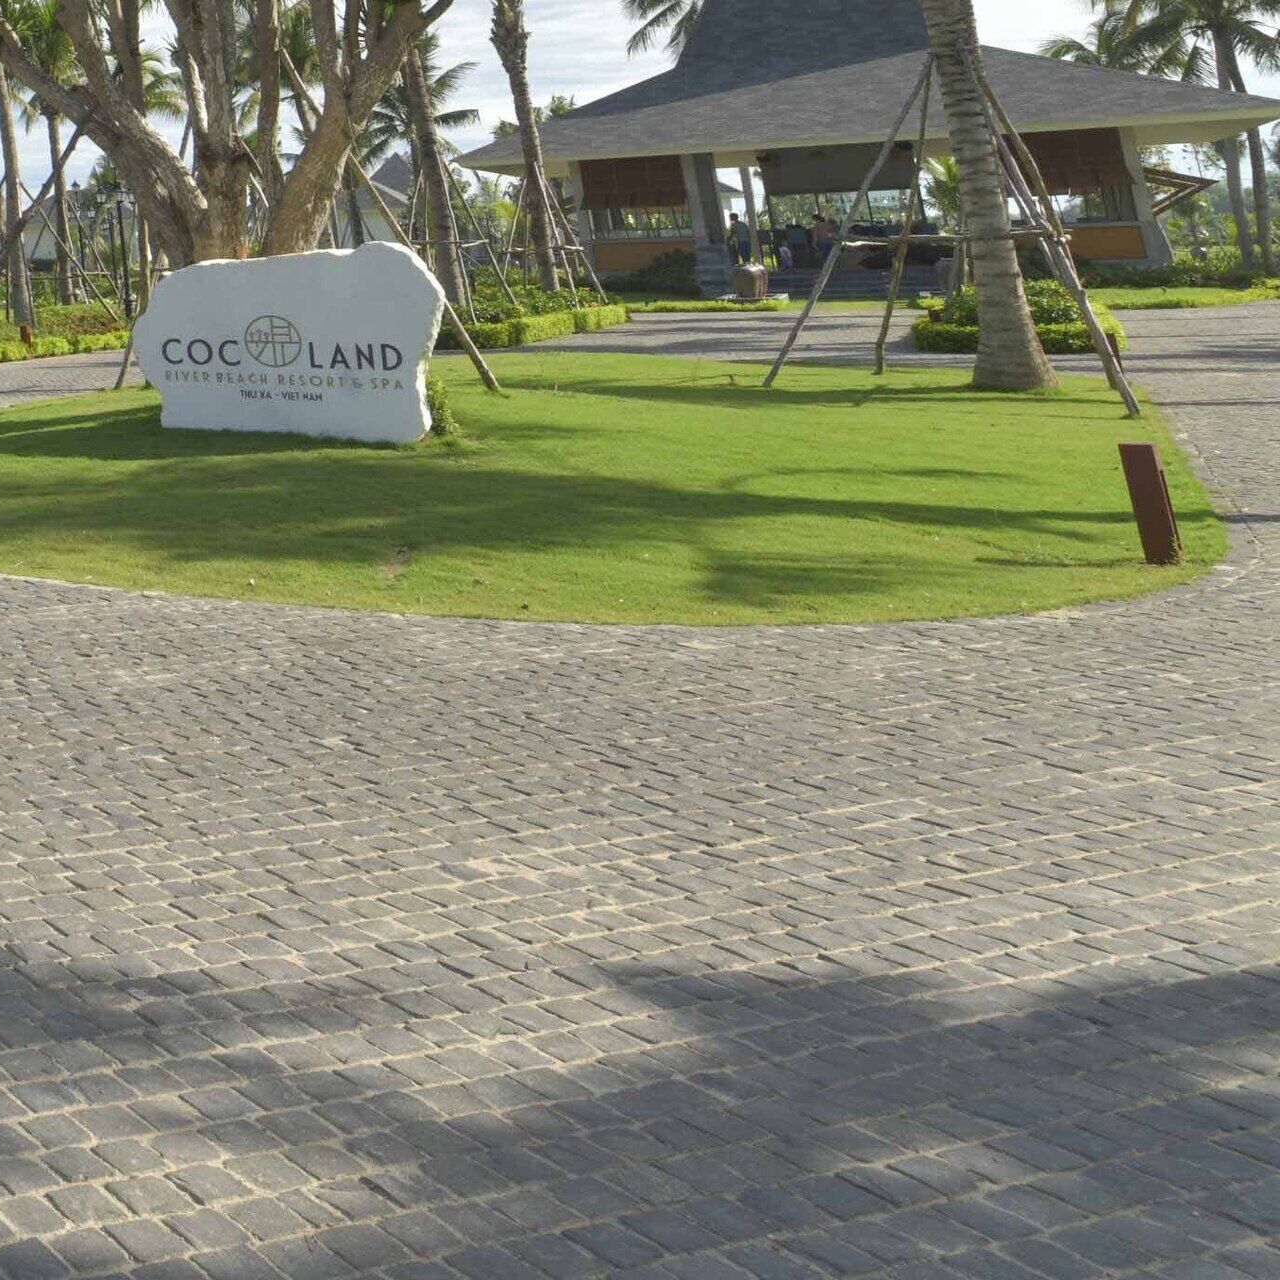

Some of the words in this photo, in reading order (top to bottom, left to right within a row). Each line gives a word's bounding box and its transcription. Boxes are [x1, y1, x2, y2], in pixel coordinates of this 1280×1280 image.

[165, 371, 210, 383] RIVER
[216, 372, 268, 386] BEACH
[278, 374, 344, 388] RESORT
[352, 377, 363, 389] &
[370, 377, 404, 390] SPA
[281, 391, 300, 402] VIET
[302, 392, 323, 403] NAM
